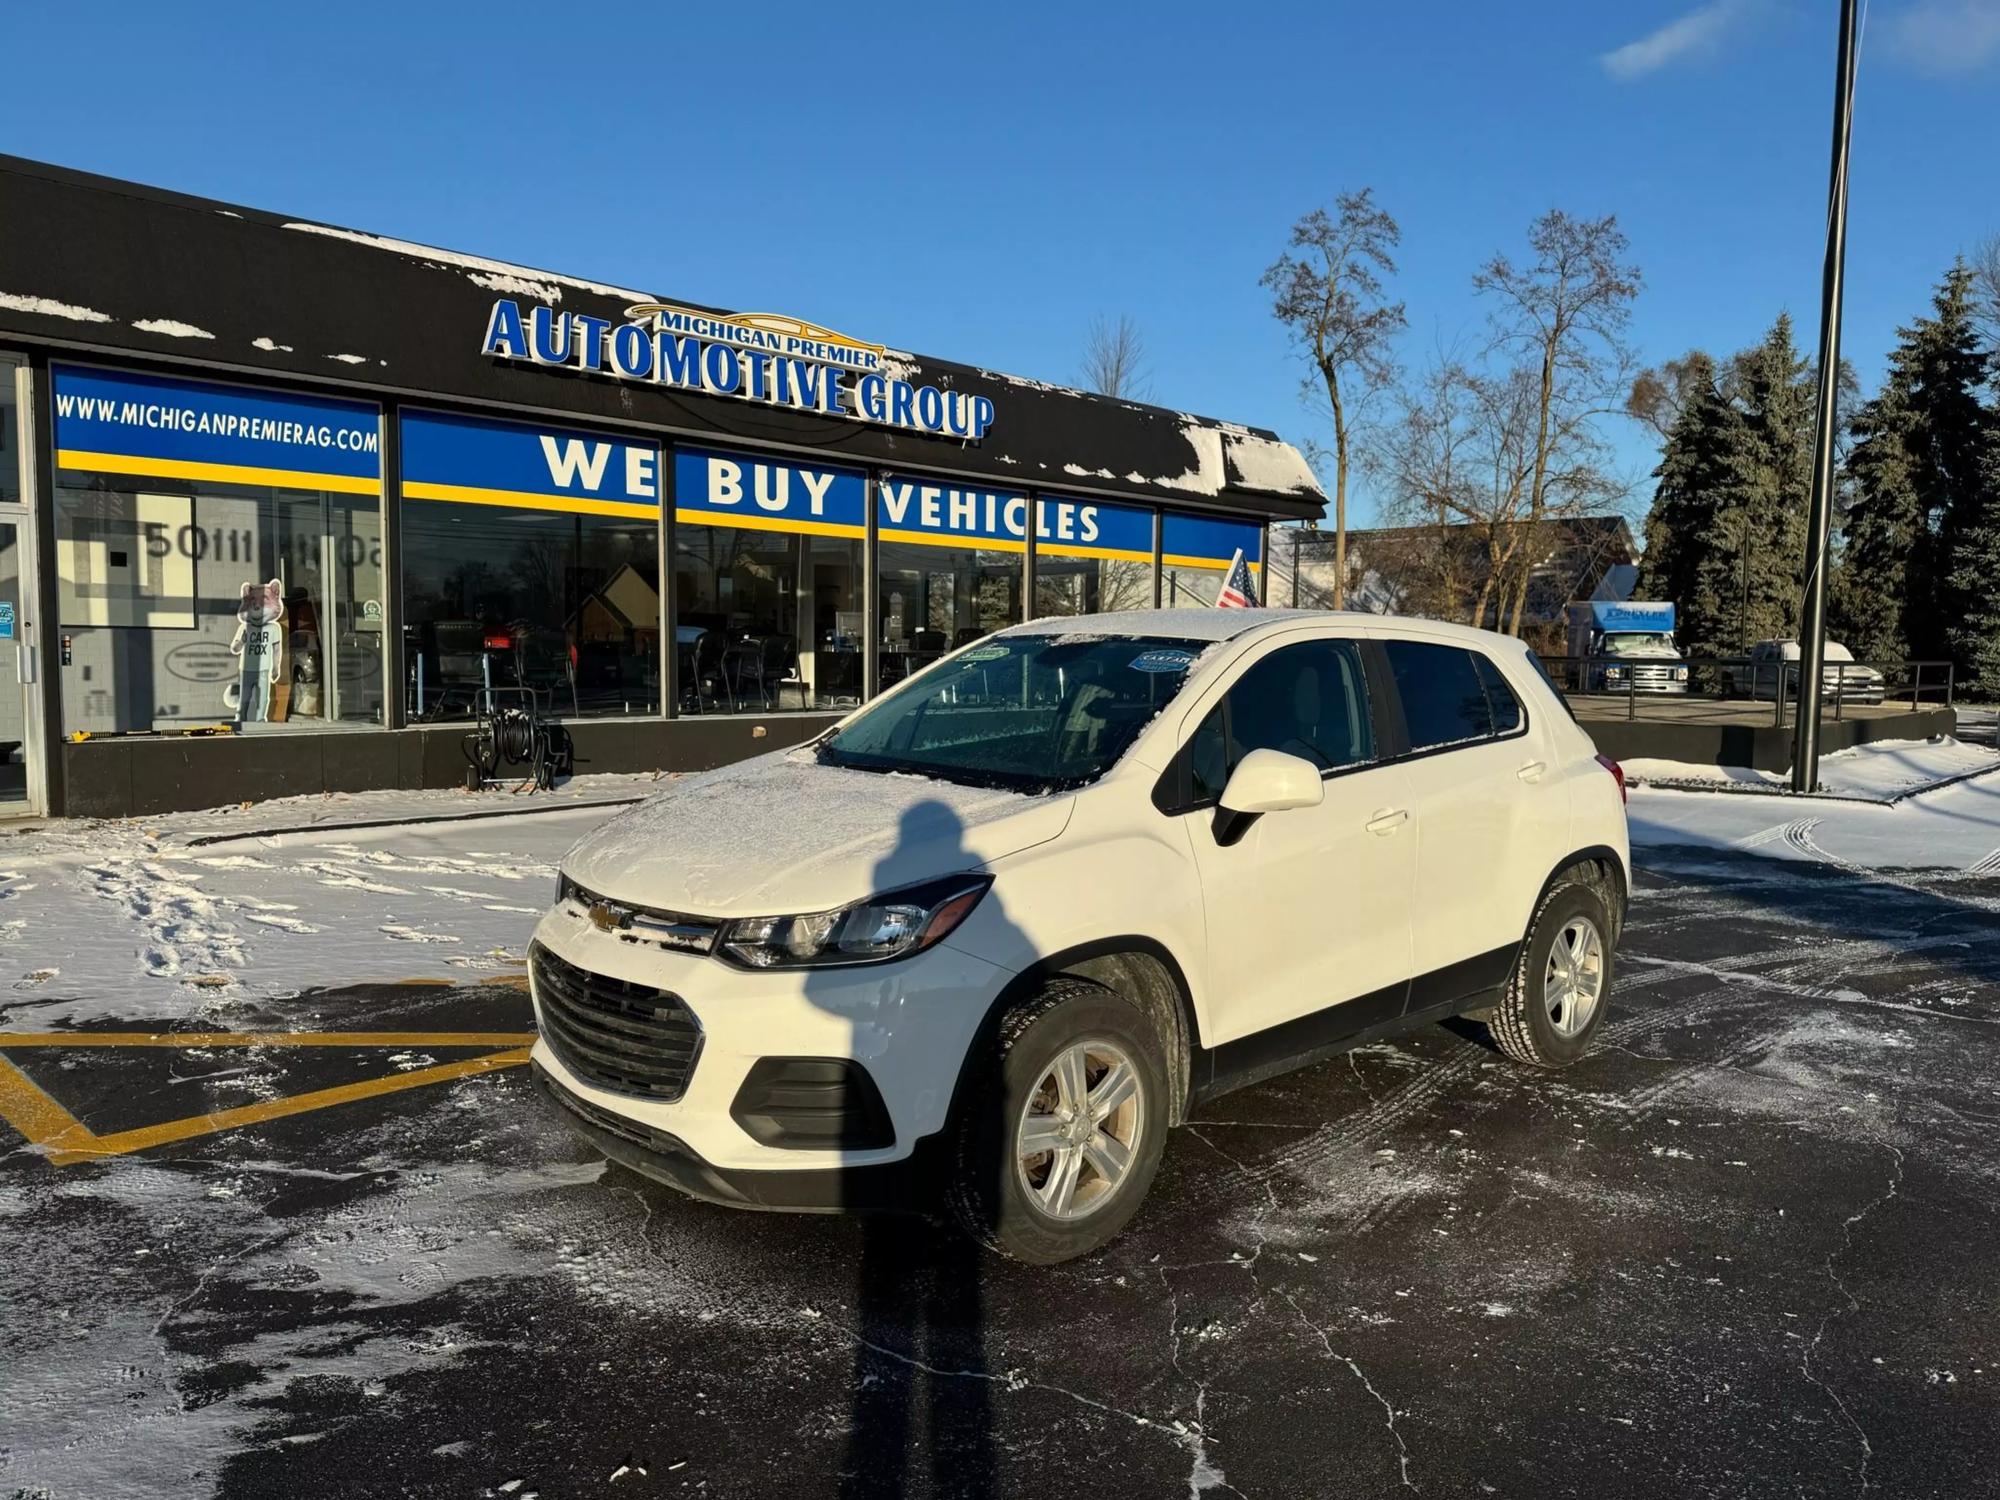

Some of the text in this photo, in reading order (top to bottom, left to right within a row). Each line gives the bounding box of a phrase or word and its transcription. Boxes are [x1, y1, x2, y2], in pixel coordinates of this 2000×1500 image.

[481, 299, 995, 438] AUTOMOTIVE GROUP
[660, 310, 878, 369] MICHIGAN PREMIER
[56, 394, 378, 453] WWW.MICHIGANPREMIERAG.COM
[539, 435, 1099, 542] WE BUY VEHICLES
[248, 644, 267, 656] FOX
[250, 631, 269, 643] CAR
